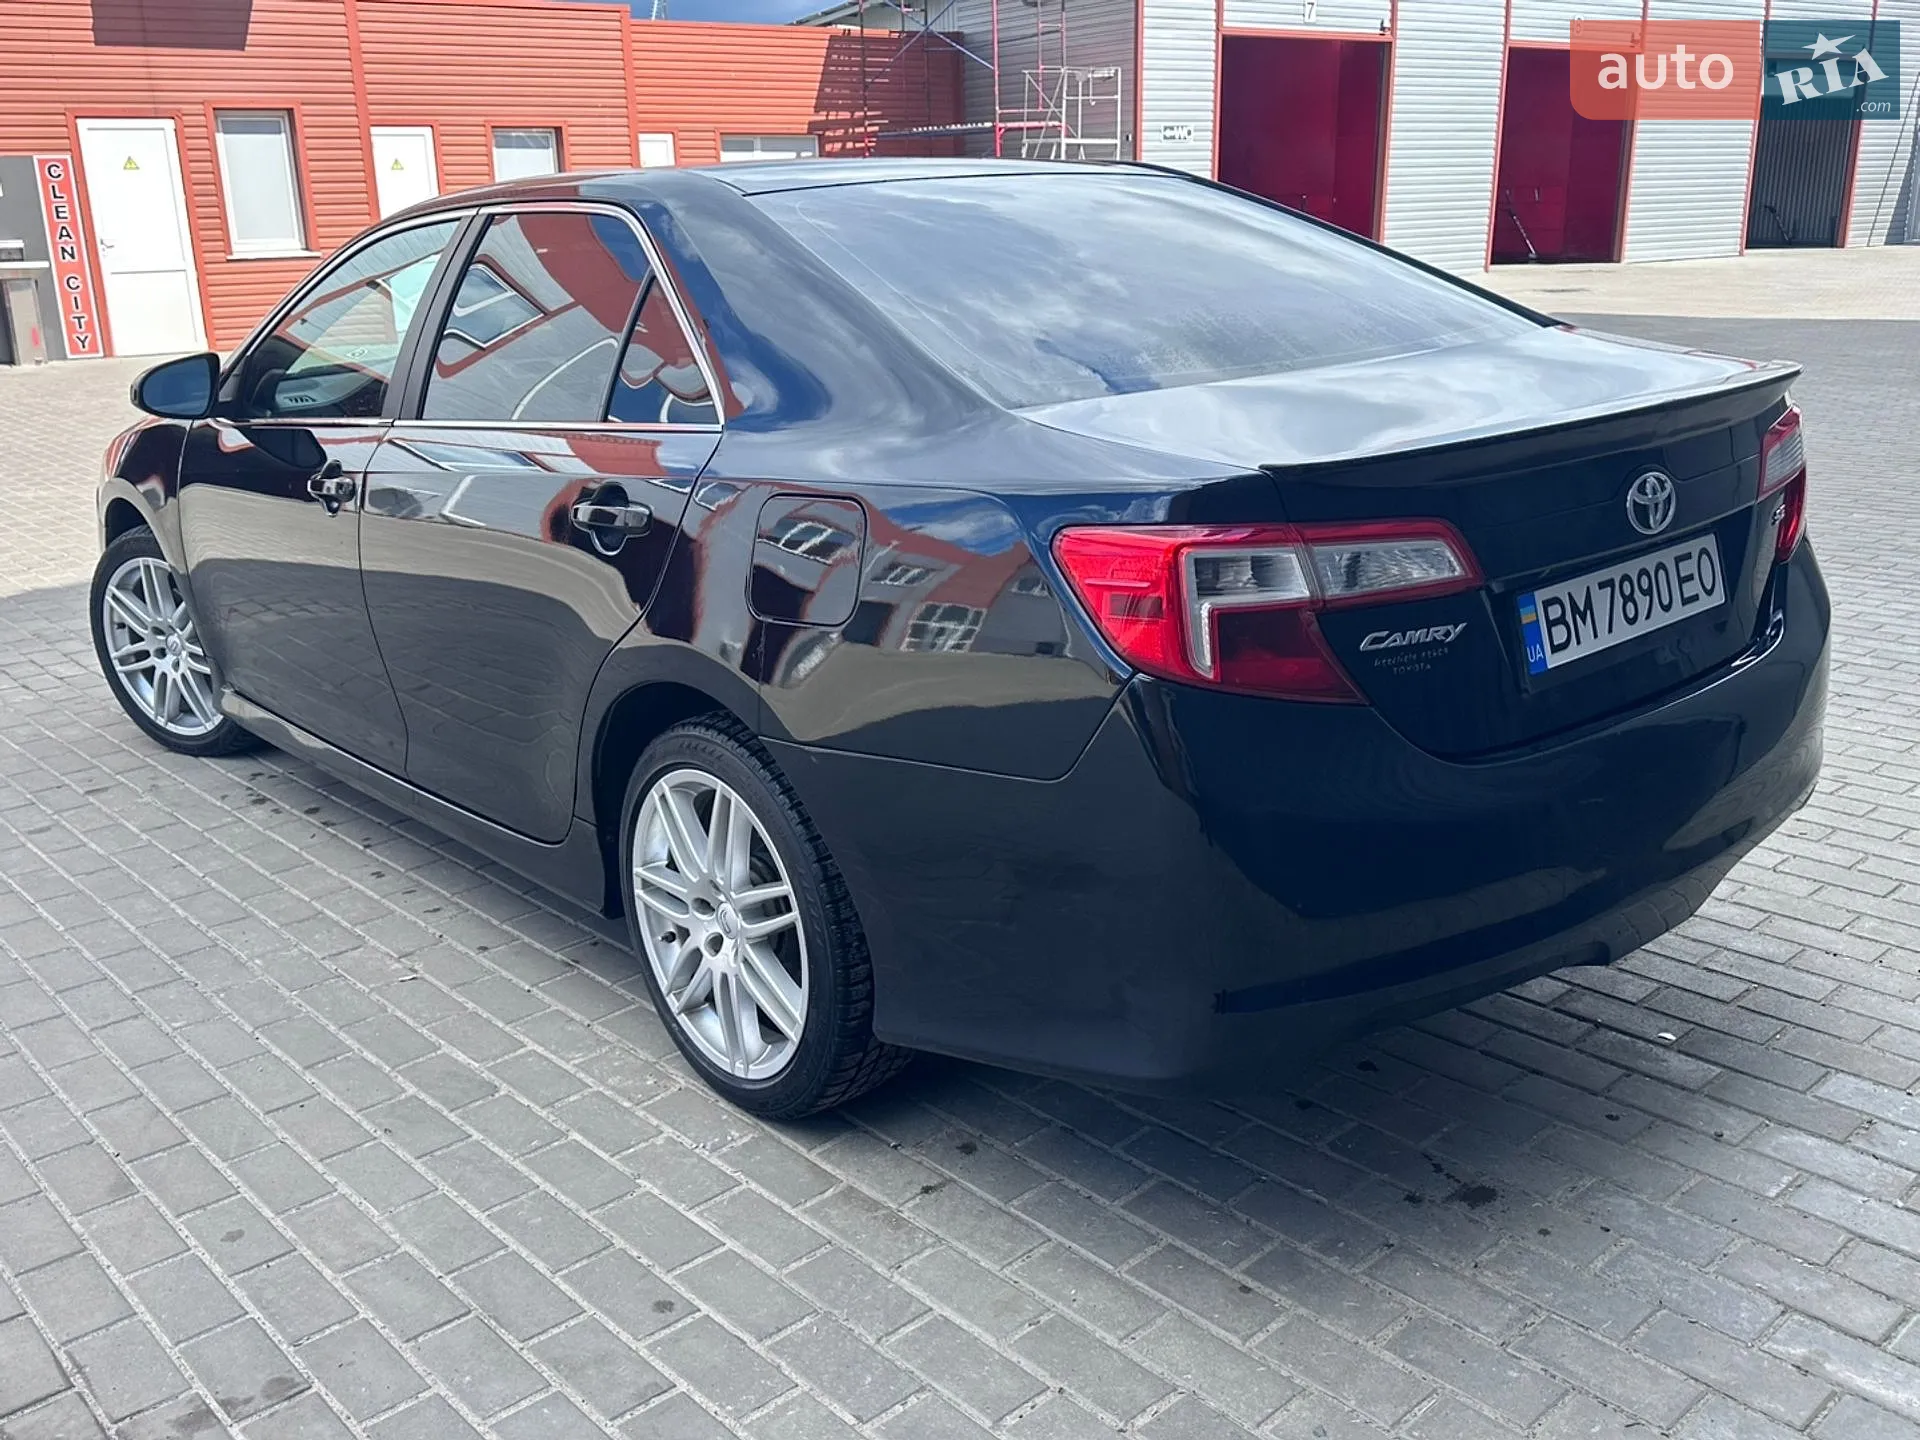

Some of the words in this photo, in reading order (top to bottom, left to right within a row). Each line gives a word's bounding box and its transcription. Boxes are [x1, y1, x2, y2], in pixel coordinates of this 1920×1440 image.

[1306, 2, 1316, 20] 7
[46, 163, 76, 260] CLEAN
[66, 275, 90, 349] CITY
[1359, 622, 1468, 652] CAMRY
[1526, 640, 1545, 663] UA
[1393, 662, 1432, 676] TOYOTA
